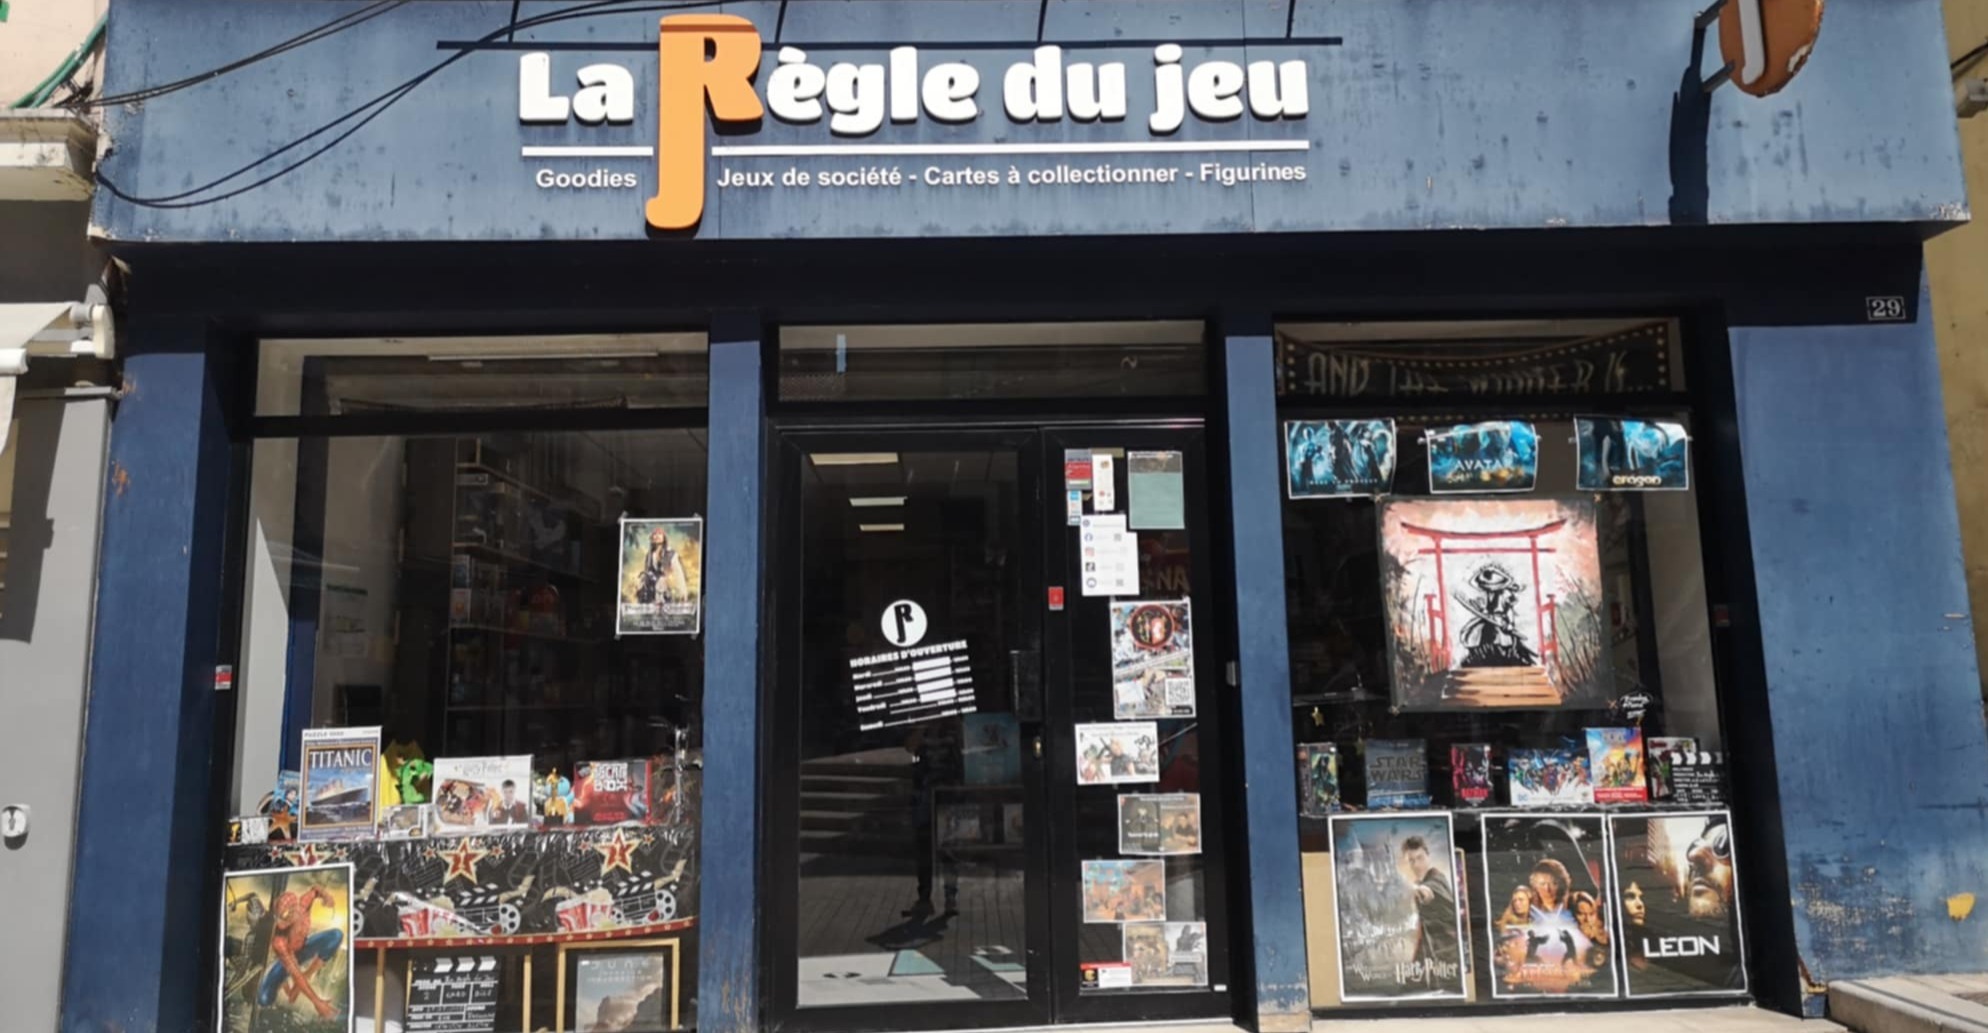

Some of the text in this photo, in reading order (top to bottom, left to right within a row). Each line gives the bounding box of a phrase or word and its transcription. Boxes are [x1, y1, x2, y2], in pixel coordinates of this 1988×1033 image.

[520, 13, 1309, 228] La Règle du jeu
[536, 168, 638, 188] Goodies
[717, 168, 775, 187] Jeux
[782, 168, 811, 187] de
[818, 166, 902, 187] société
[924, 166, 1000, 186] Cartes
[1007, 164, 1021, 184] à
[1027, 164, 1178, 184] collectionner
[1200, 162, 1307, 187] Figurines
[1872, 299, 1901, 317] 29
[1303, 352, 1371, 397] AND
[1454, 457, 1513, 471] AVATA
[850, 651, 900, 668] HORAIRES
[901, 639, 968, 660] D'OUVERTURE
[309, 748, 373, 769] TITANIC
[1370, 756, 1428, 769] STAR
[1370, 769, 1425, 782] WARS
[1643, 935, 1721, 958] LEON
[1395, 961, 1425, 985] Harry
[1424, 958, 1459, 989] Potter
